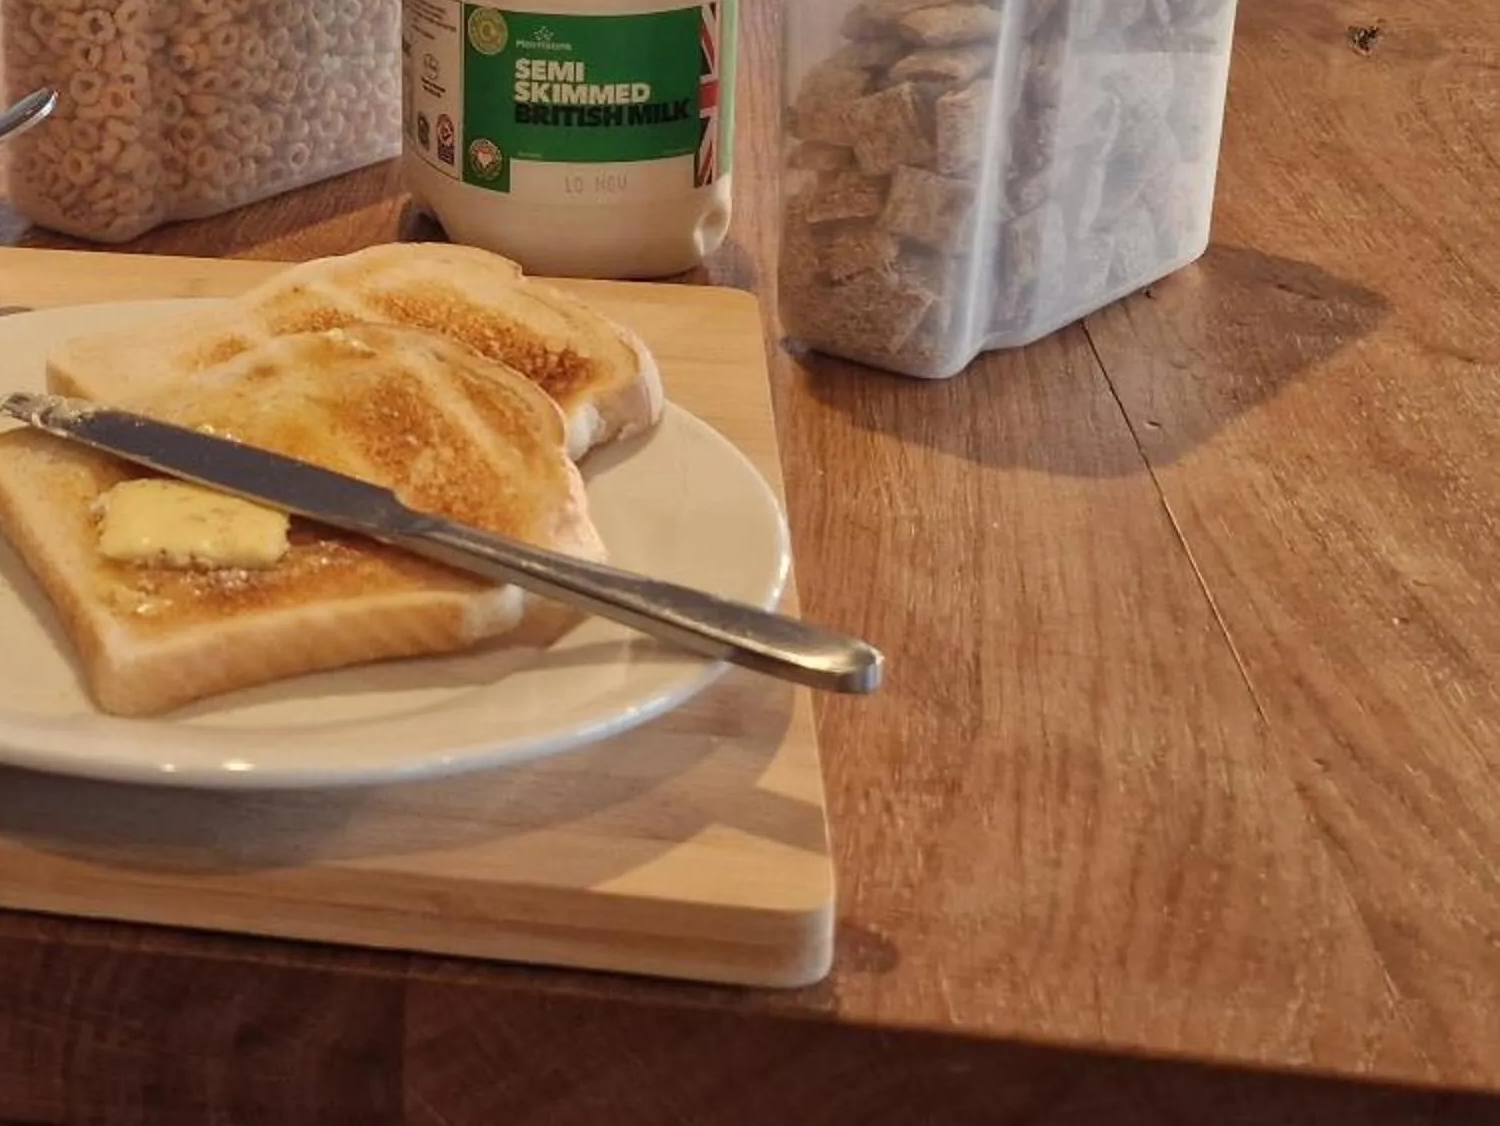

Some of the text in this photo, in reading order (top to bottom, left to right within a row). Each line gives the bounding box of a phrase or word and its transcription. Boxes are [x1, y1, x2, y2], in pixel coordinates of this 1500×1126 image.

[515, 58, 585, 83] SEMI
[514, 81, 651, 105] SKIMMED
[515, 97, 693, 127] BRITISH MILK
